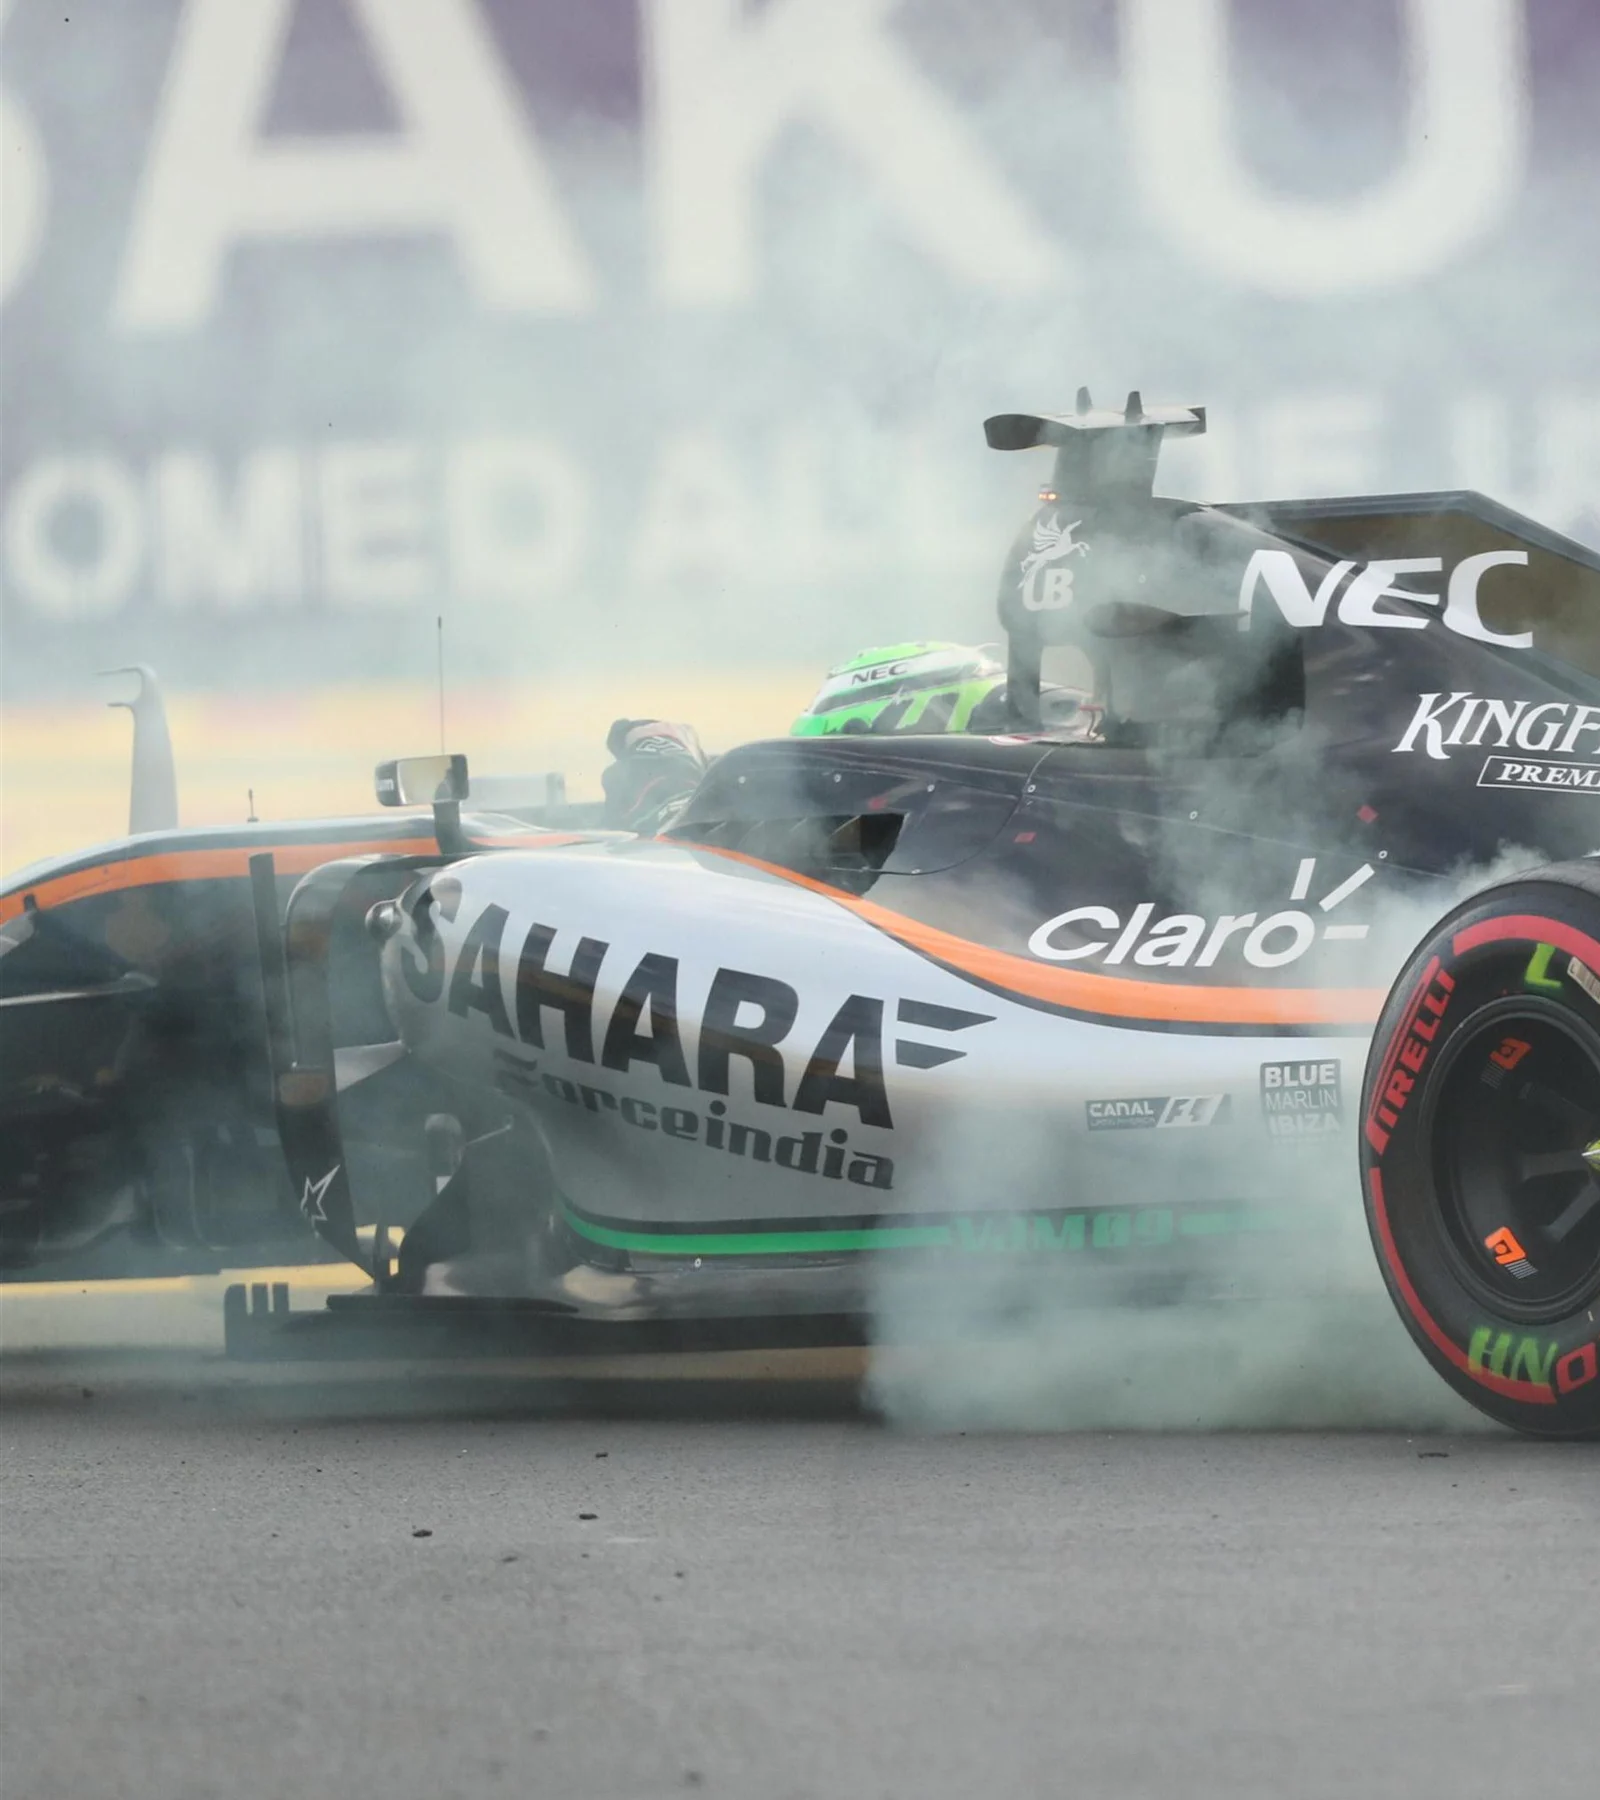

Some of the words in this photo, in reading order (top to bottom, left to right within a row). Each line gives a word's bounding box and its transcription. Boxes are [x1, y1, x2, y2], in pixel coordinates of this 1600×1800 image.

[0, 0, 1535, 330] AKU
[1238, 550, 1534, 649] NEC
[850, 664, 909, 686] NEC
[402, 877, 895, 1130] SAHARA
[1365, 955, 1456, 1157] PIRELLI
[1264, 1063, 1336, 1088] BLUE
[1089, 1101, 1154, 1119] CANAL
[1264, 1089, 1339, 1111] MARLIN
[1269, 1113, 1341, 1136] IBIZA
